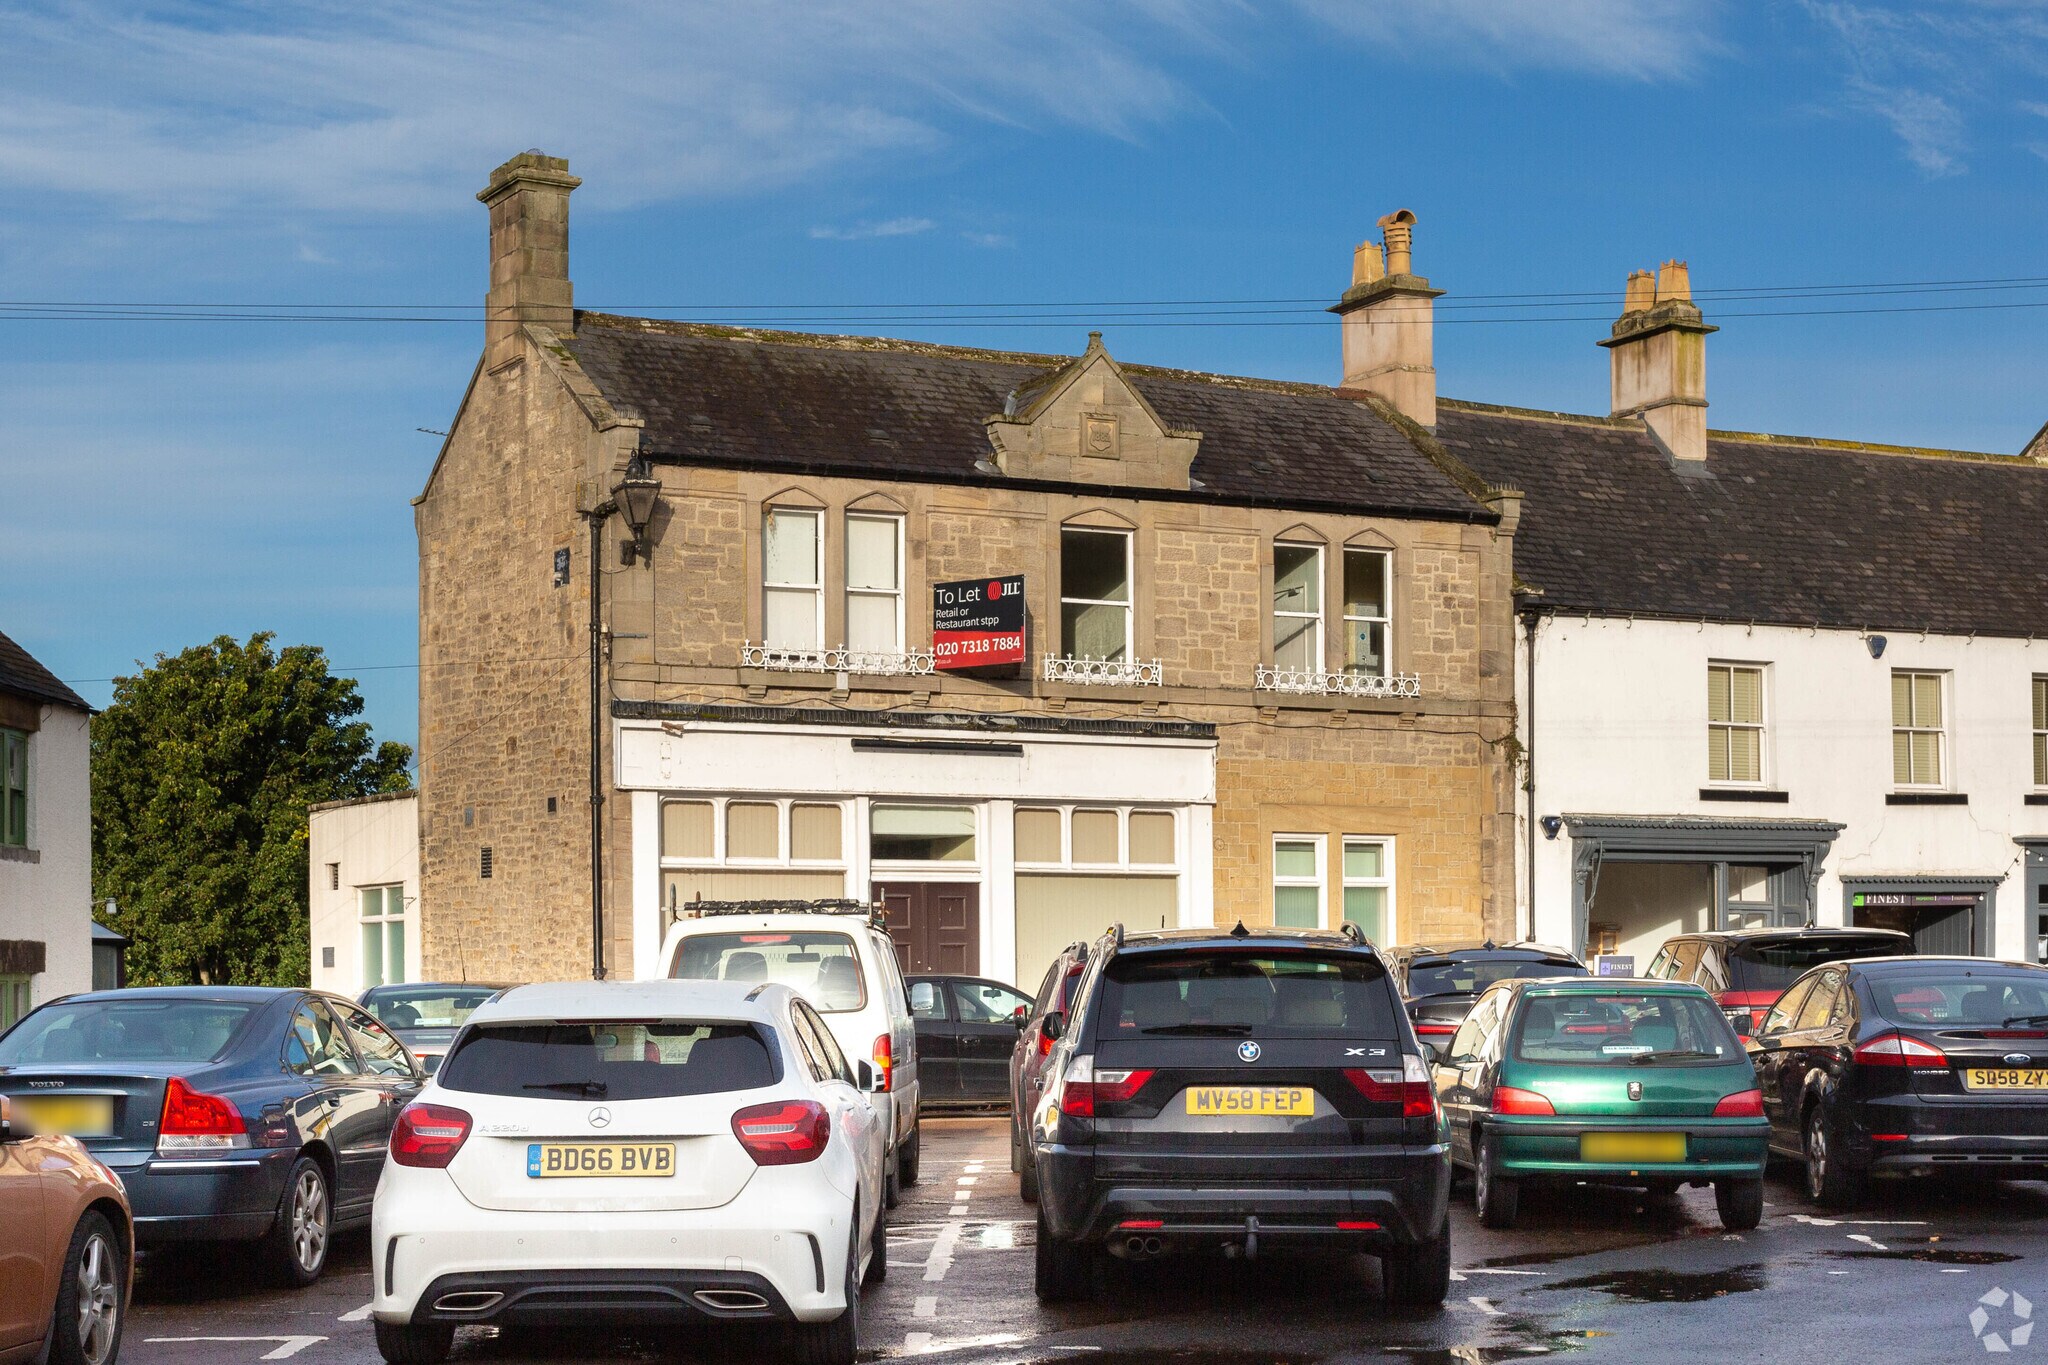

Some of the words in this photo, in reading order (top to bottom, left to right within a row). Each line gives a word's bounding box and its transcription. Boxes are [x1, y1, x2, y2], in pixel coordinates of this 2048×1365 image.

[936, 589, 954, 604] To
[958, 587, 980, 602] Let
[1001, 582, 1020, 596] JLL
[936, 607, 958, 618] Retail
[960, 608, 969, 616] or
[936, 618, 979, 629] Restaurant
[981, 616, 999, 627] stpp
[936, 642, 958, 655] 020
[961, 640, 989, 654] 7318
[992, 636, 1020, 651] 7884
[1866, 894, 1907, 904] FINEST
[1344, 1048, 1386, 1056] X3
[1197, 1090, 1254, 1110] MV58
[1261, 1090, 1302, 1110] FEP
[547, 1148, 613, 1171] BD66
[621, 1147, 670, 1170] BVB
